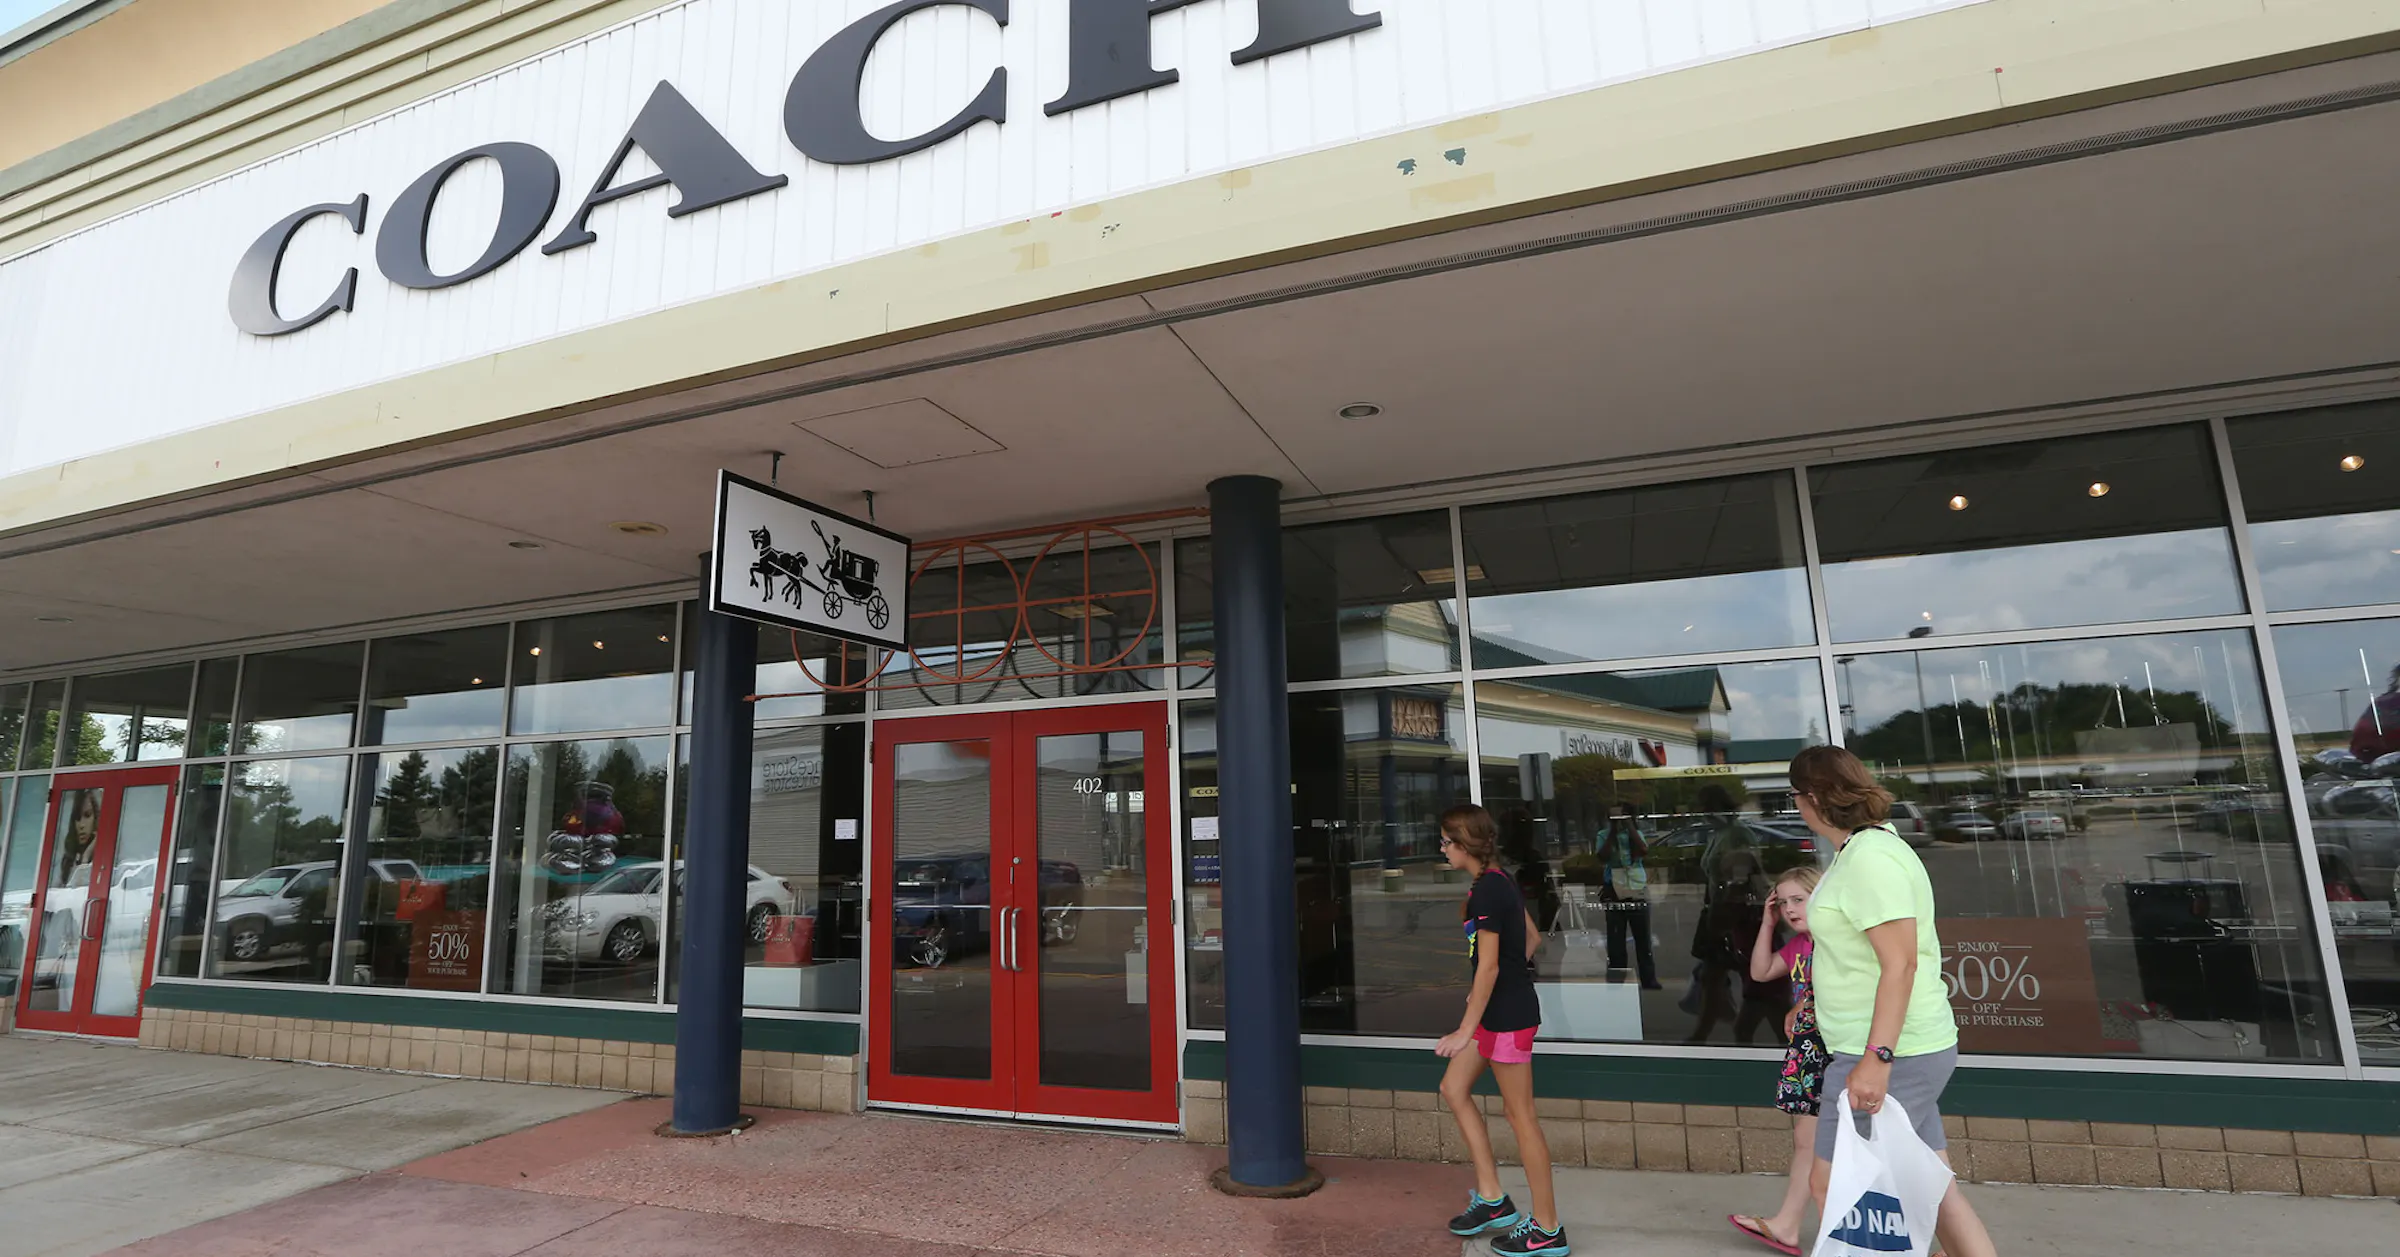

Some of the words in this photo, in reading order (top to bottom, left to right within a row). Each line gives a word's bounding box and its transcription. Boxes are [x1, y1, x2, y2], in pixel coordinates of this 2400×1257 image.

[1072, 777, 1103, 794] 402
[428, 932, 469, 960] 50%
[1957, 941, 2000, 953] ENJOY
[1972, 1003, 2002, 1014] OFF
[1973, 1014, 2045, 1027] PURCHASE
